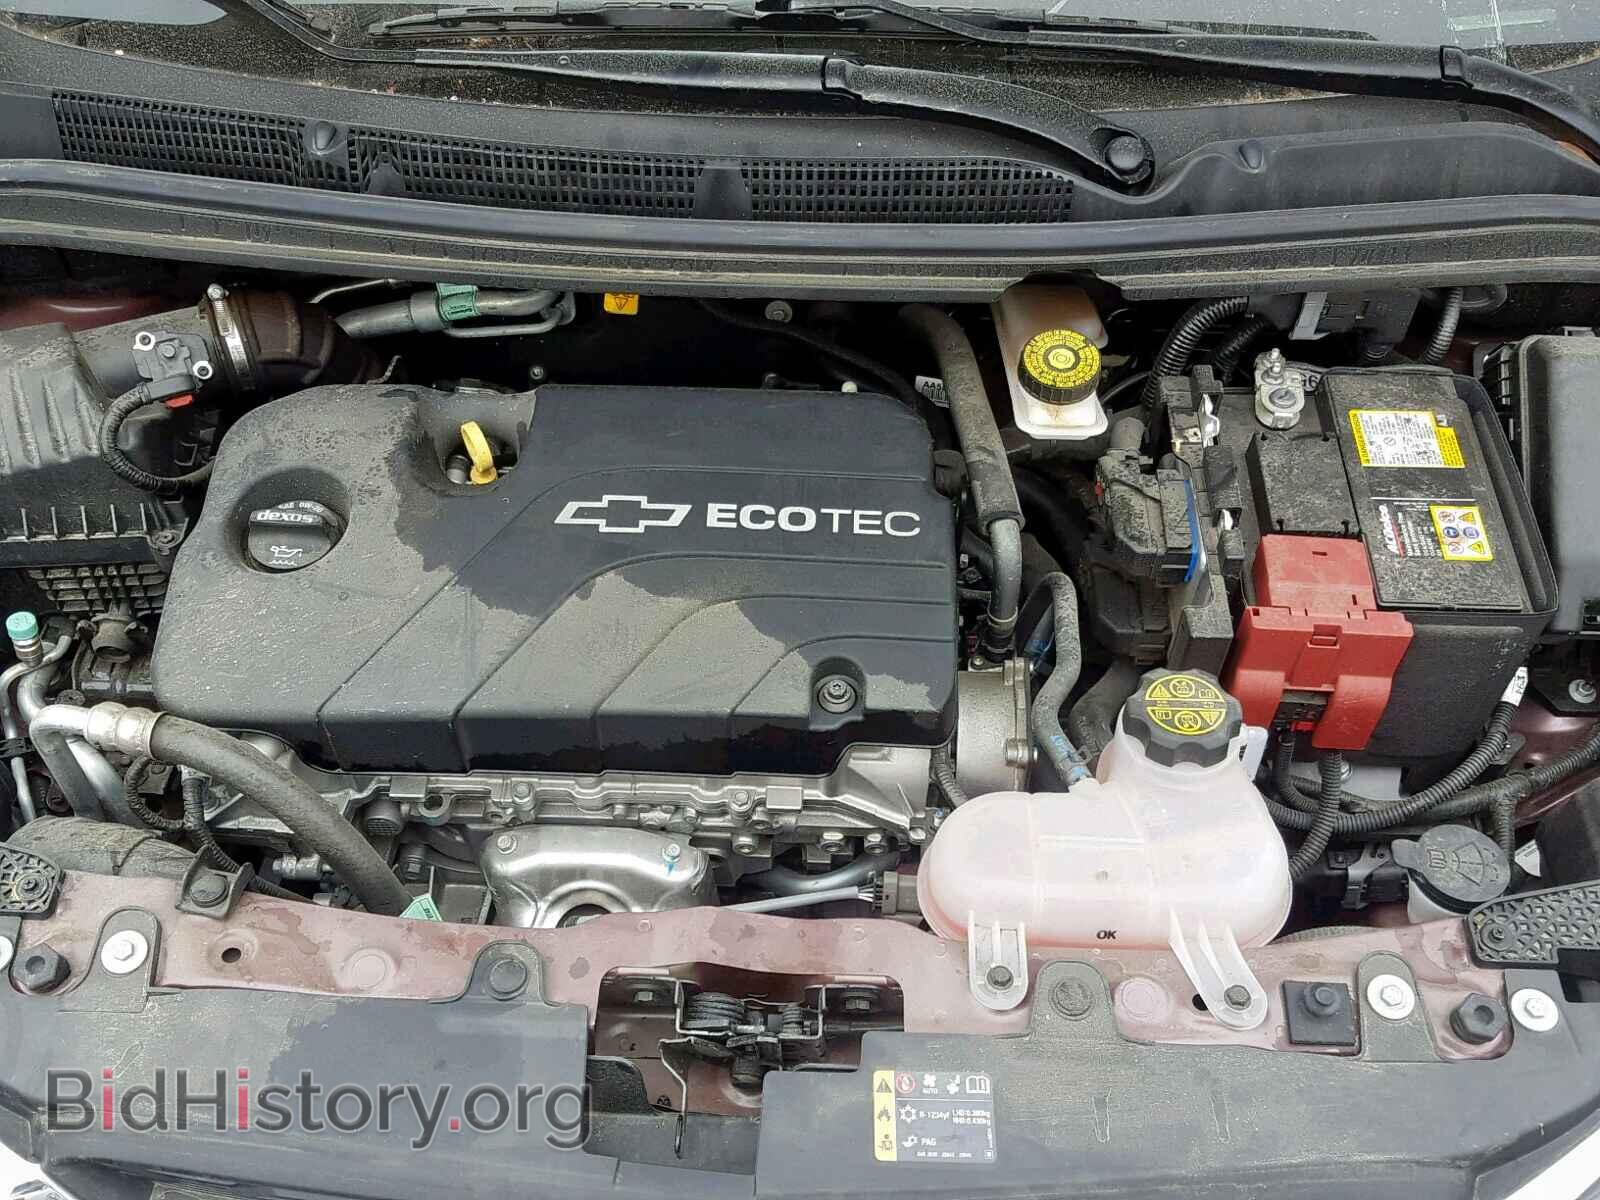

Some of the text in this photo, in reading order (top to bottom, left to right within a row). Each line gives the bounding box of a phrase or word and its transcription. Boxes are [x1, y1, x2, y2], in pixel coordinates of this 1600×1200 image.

[256, 510, 313, 523] dexos
[706, 503, 921, 537] ECOTEC
[1096, 930, 1117, 940] OK
[921, 1137, 937, 1146] PAG
